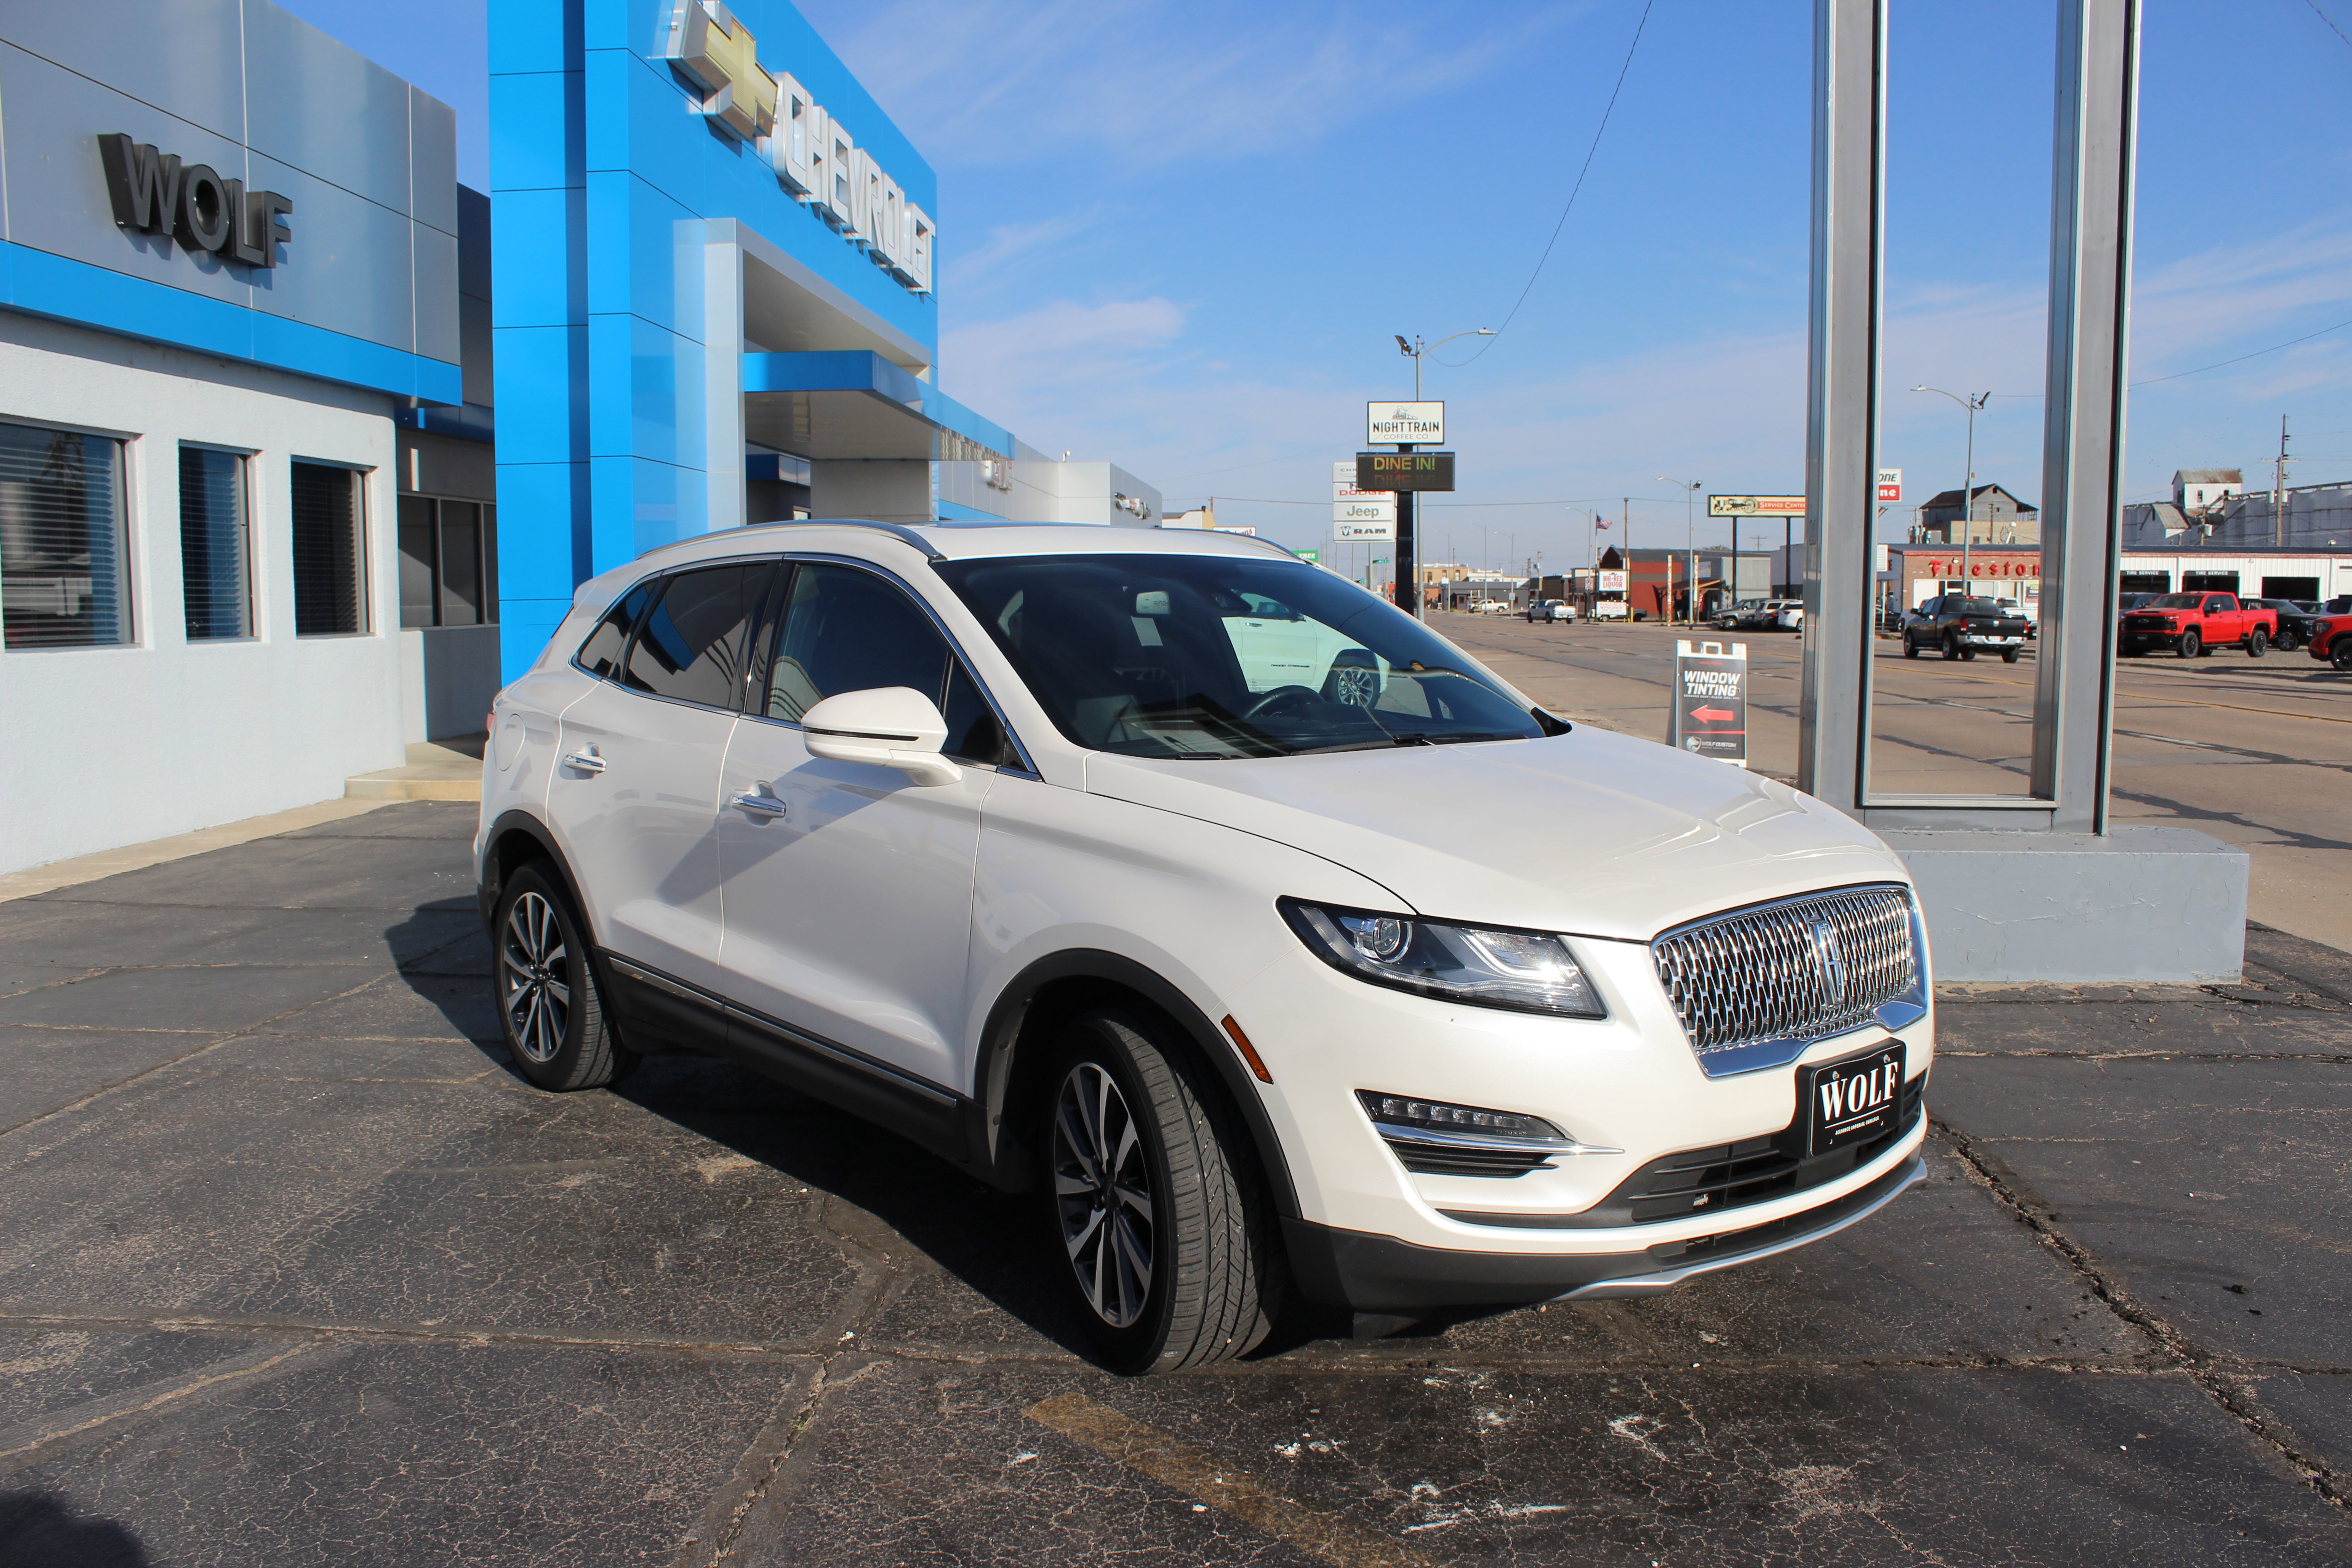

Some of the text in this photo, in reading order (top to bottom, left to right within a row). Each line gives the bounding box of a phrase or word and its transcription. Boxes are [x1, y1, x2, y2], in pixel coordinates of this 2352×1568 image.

[773, 71, 936, 295] CHEVROLET
[97, 132, 293, 269] WOLF
[1373, 421, 1439, 432] NIGHT TRAIN
[1374, 457, 1435, 470] DINE IN!
[1347, 505, 1379, 518] Jeep
[1684, 670, 1741, 685] WINDOW
[1686, 683, 1737, 696] TINTING
[1820, 1061, 1898, 1121] WOLF
